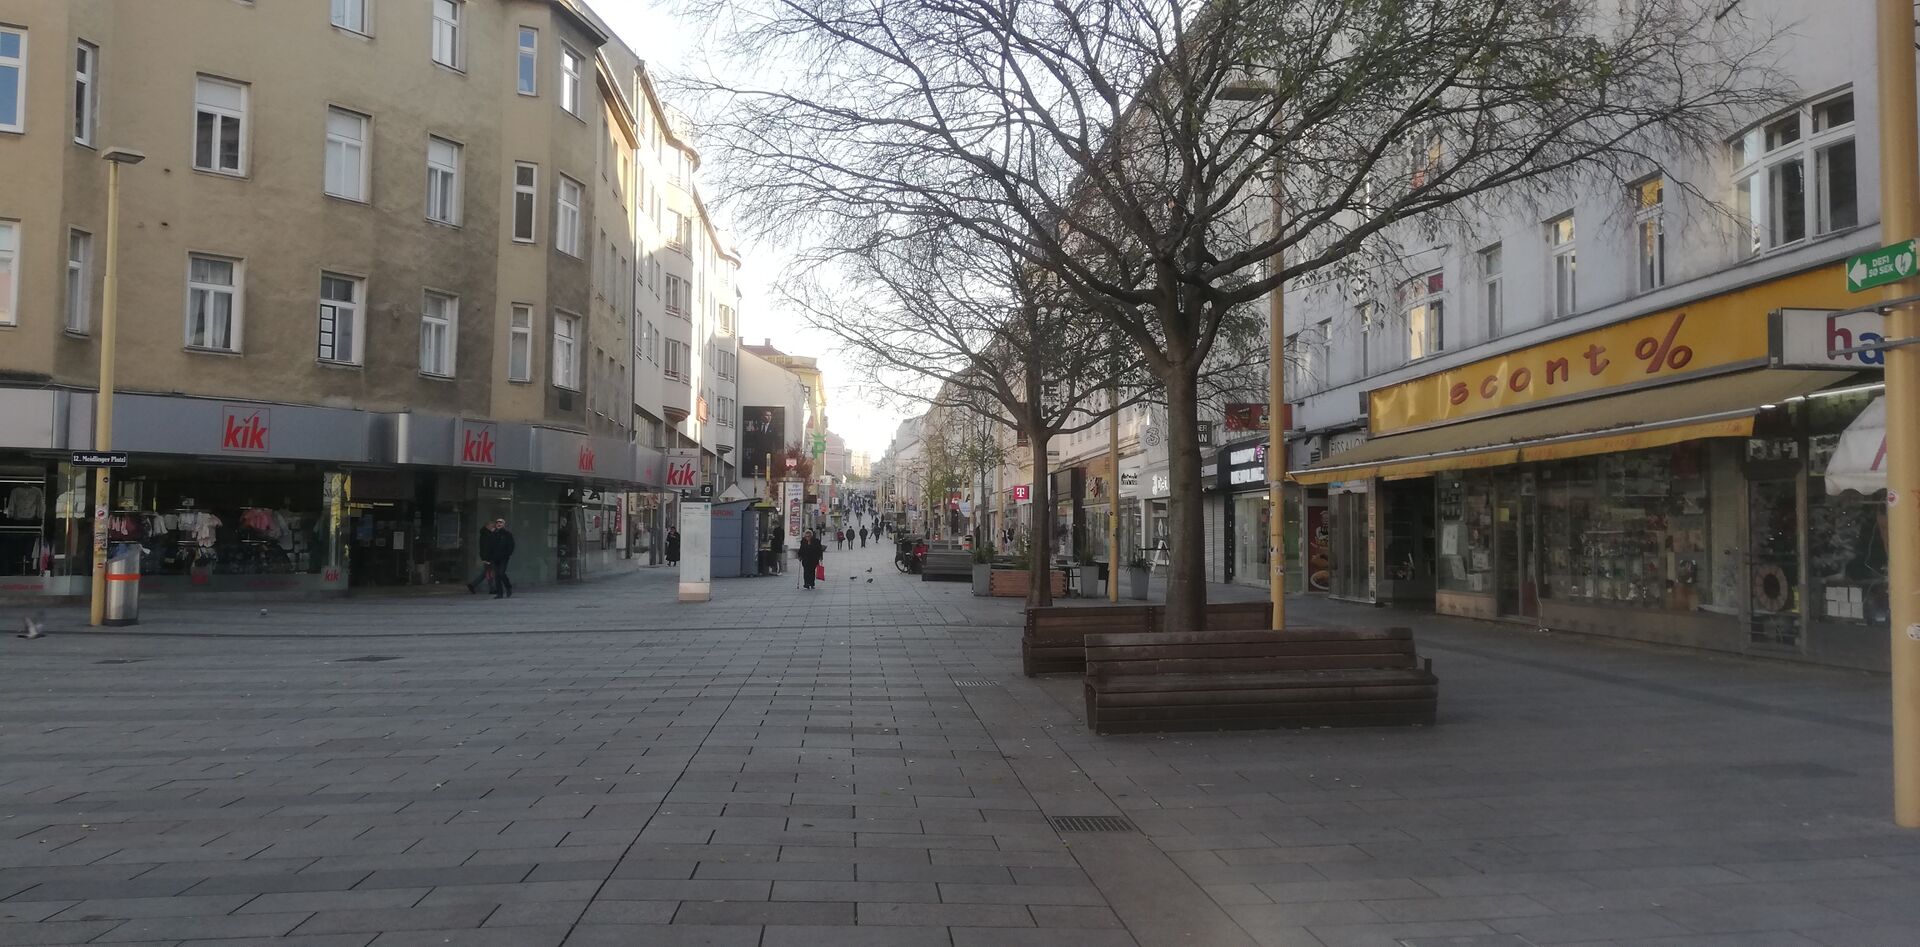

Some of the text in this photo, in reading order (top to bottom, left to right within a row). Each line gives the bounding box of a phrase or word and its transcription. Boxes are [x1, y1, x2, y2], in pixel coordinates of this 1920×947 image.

[1872, 255, 1890, 267] DEFI
[1449, 343, 1610, 406] scont
[223, 411, 267, 449] kik
[463, 427, 495, 463] kik
[578, 444, 595, 471] kik
[666, 460, 697, 486] kik
